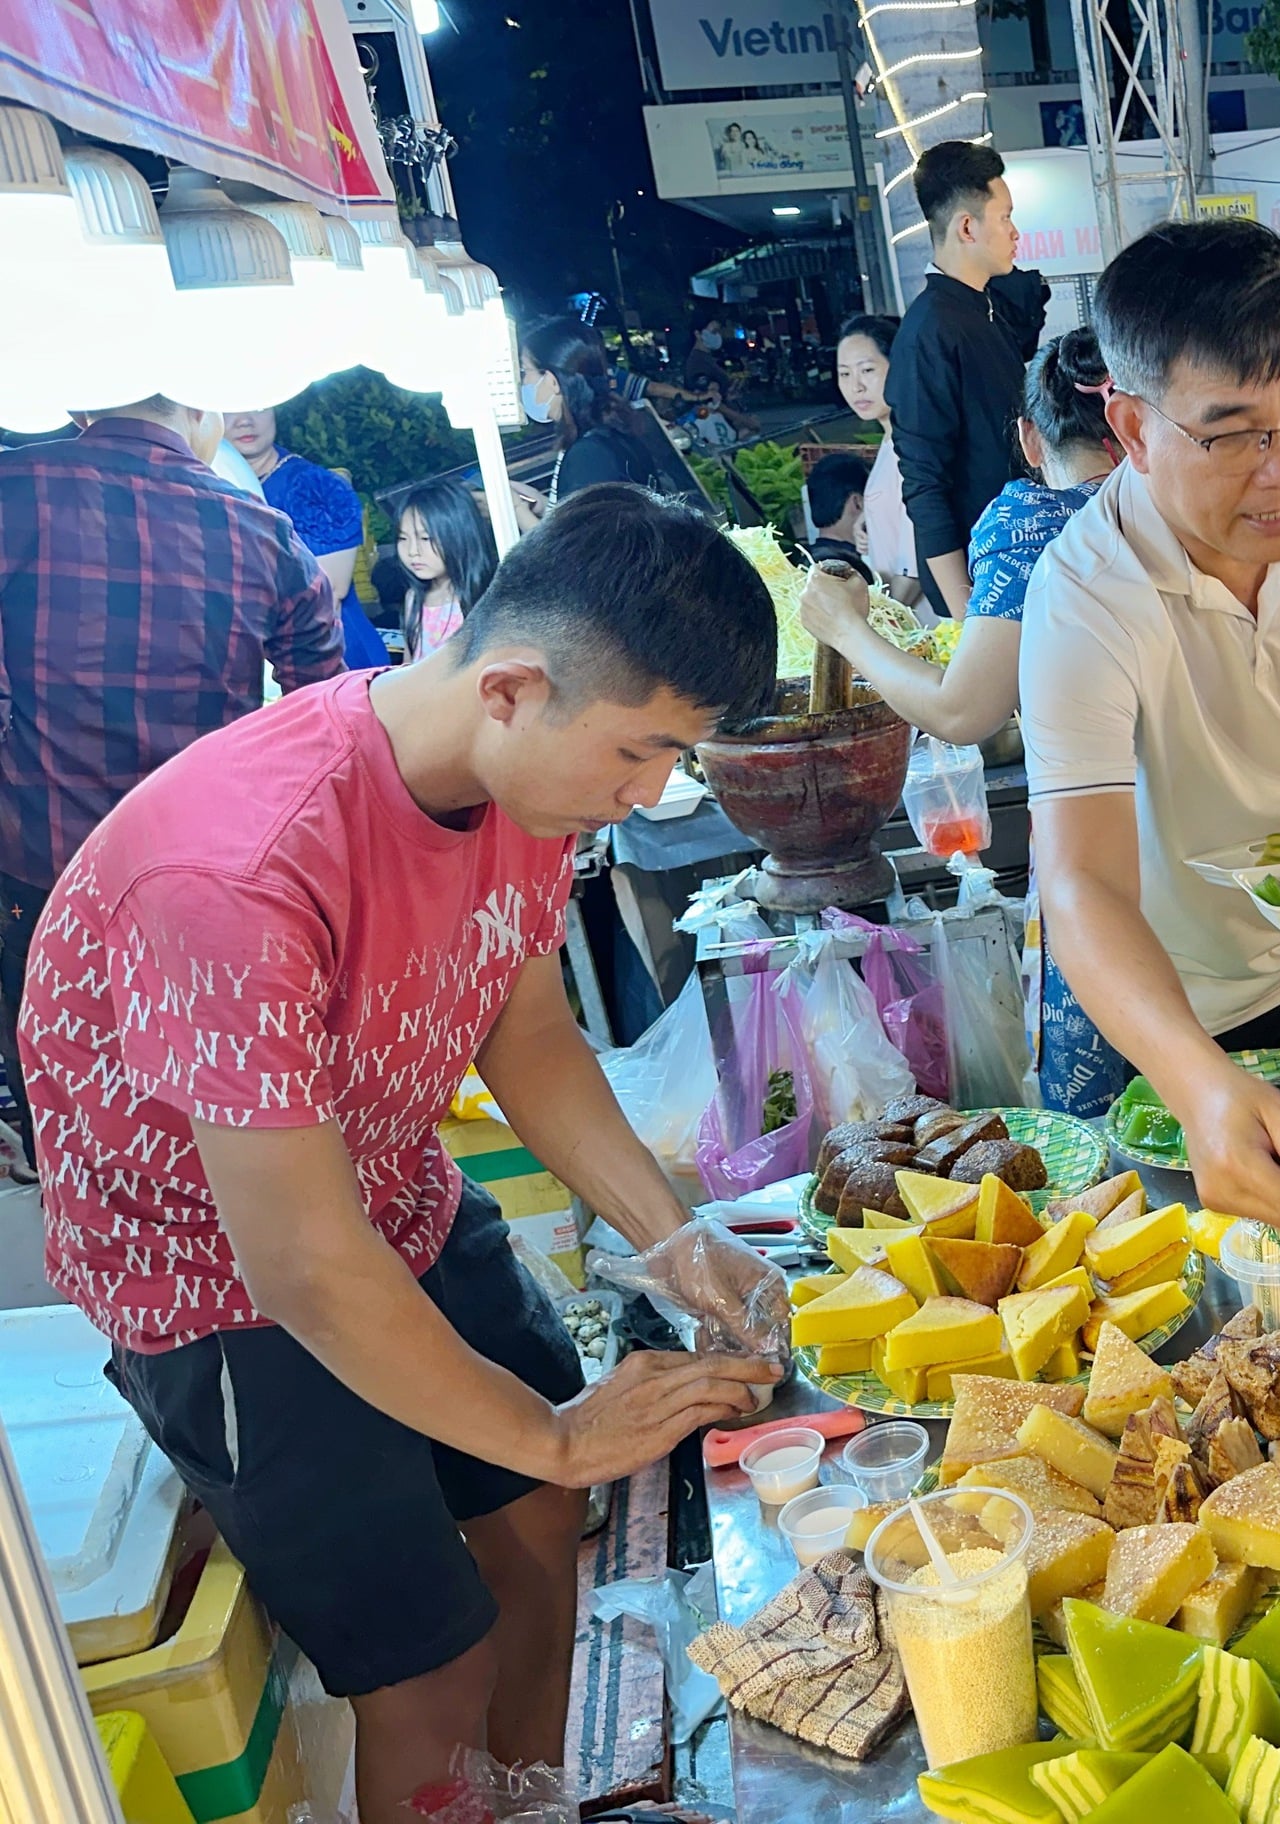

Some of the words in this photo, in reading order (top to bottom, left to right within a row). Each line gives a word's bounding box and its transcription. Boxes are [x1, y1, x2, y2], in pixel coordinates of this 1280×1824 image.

[699, 13, 866, 57] VietinB
[473, 883, 523, 967] NY
[189, 957, 252, 999] NY
[159, 976, 198, 1024] NY
[258, 1001, 315, 1037] NY
[397, 996, 437, 1042] NY
[52, 1008, 120, 1049] NY
[195, 1028, 254, 1071] NY
[425, 1007, 454, 1054] NY
[446, 1017, 481, 1061] NY
[162, 1045, 200, 1095] NY
[347, 1045, 393, 1088] NY
[383, 1055, 427, 1098] NY
[408, 1064, 445, 1108] NY
[259, 1069, 320, 1109] NY
[124, 1123, 197, 1173] NY
[356, 1152, 403, 1189] NY
[173, 1275, 235, 1309] NY
[121, 1306, 177, 1335] NY
